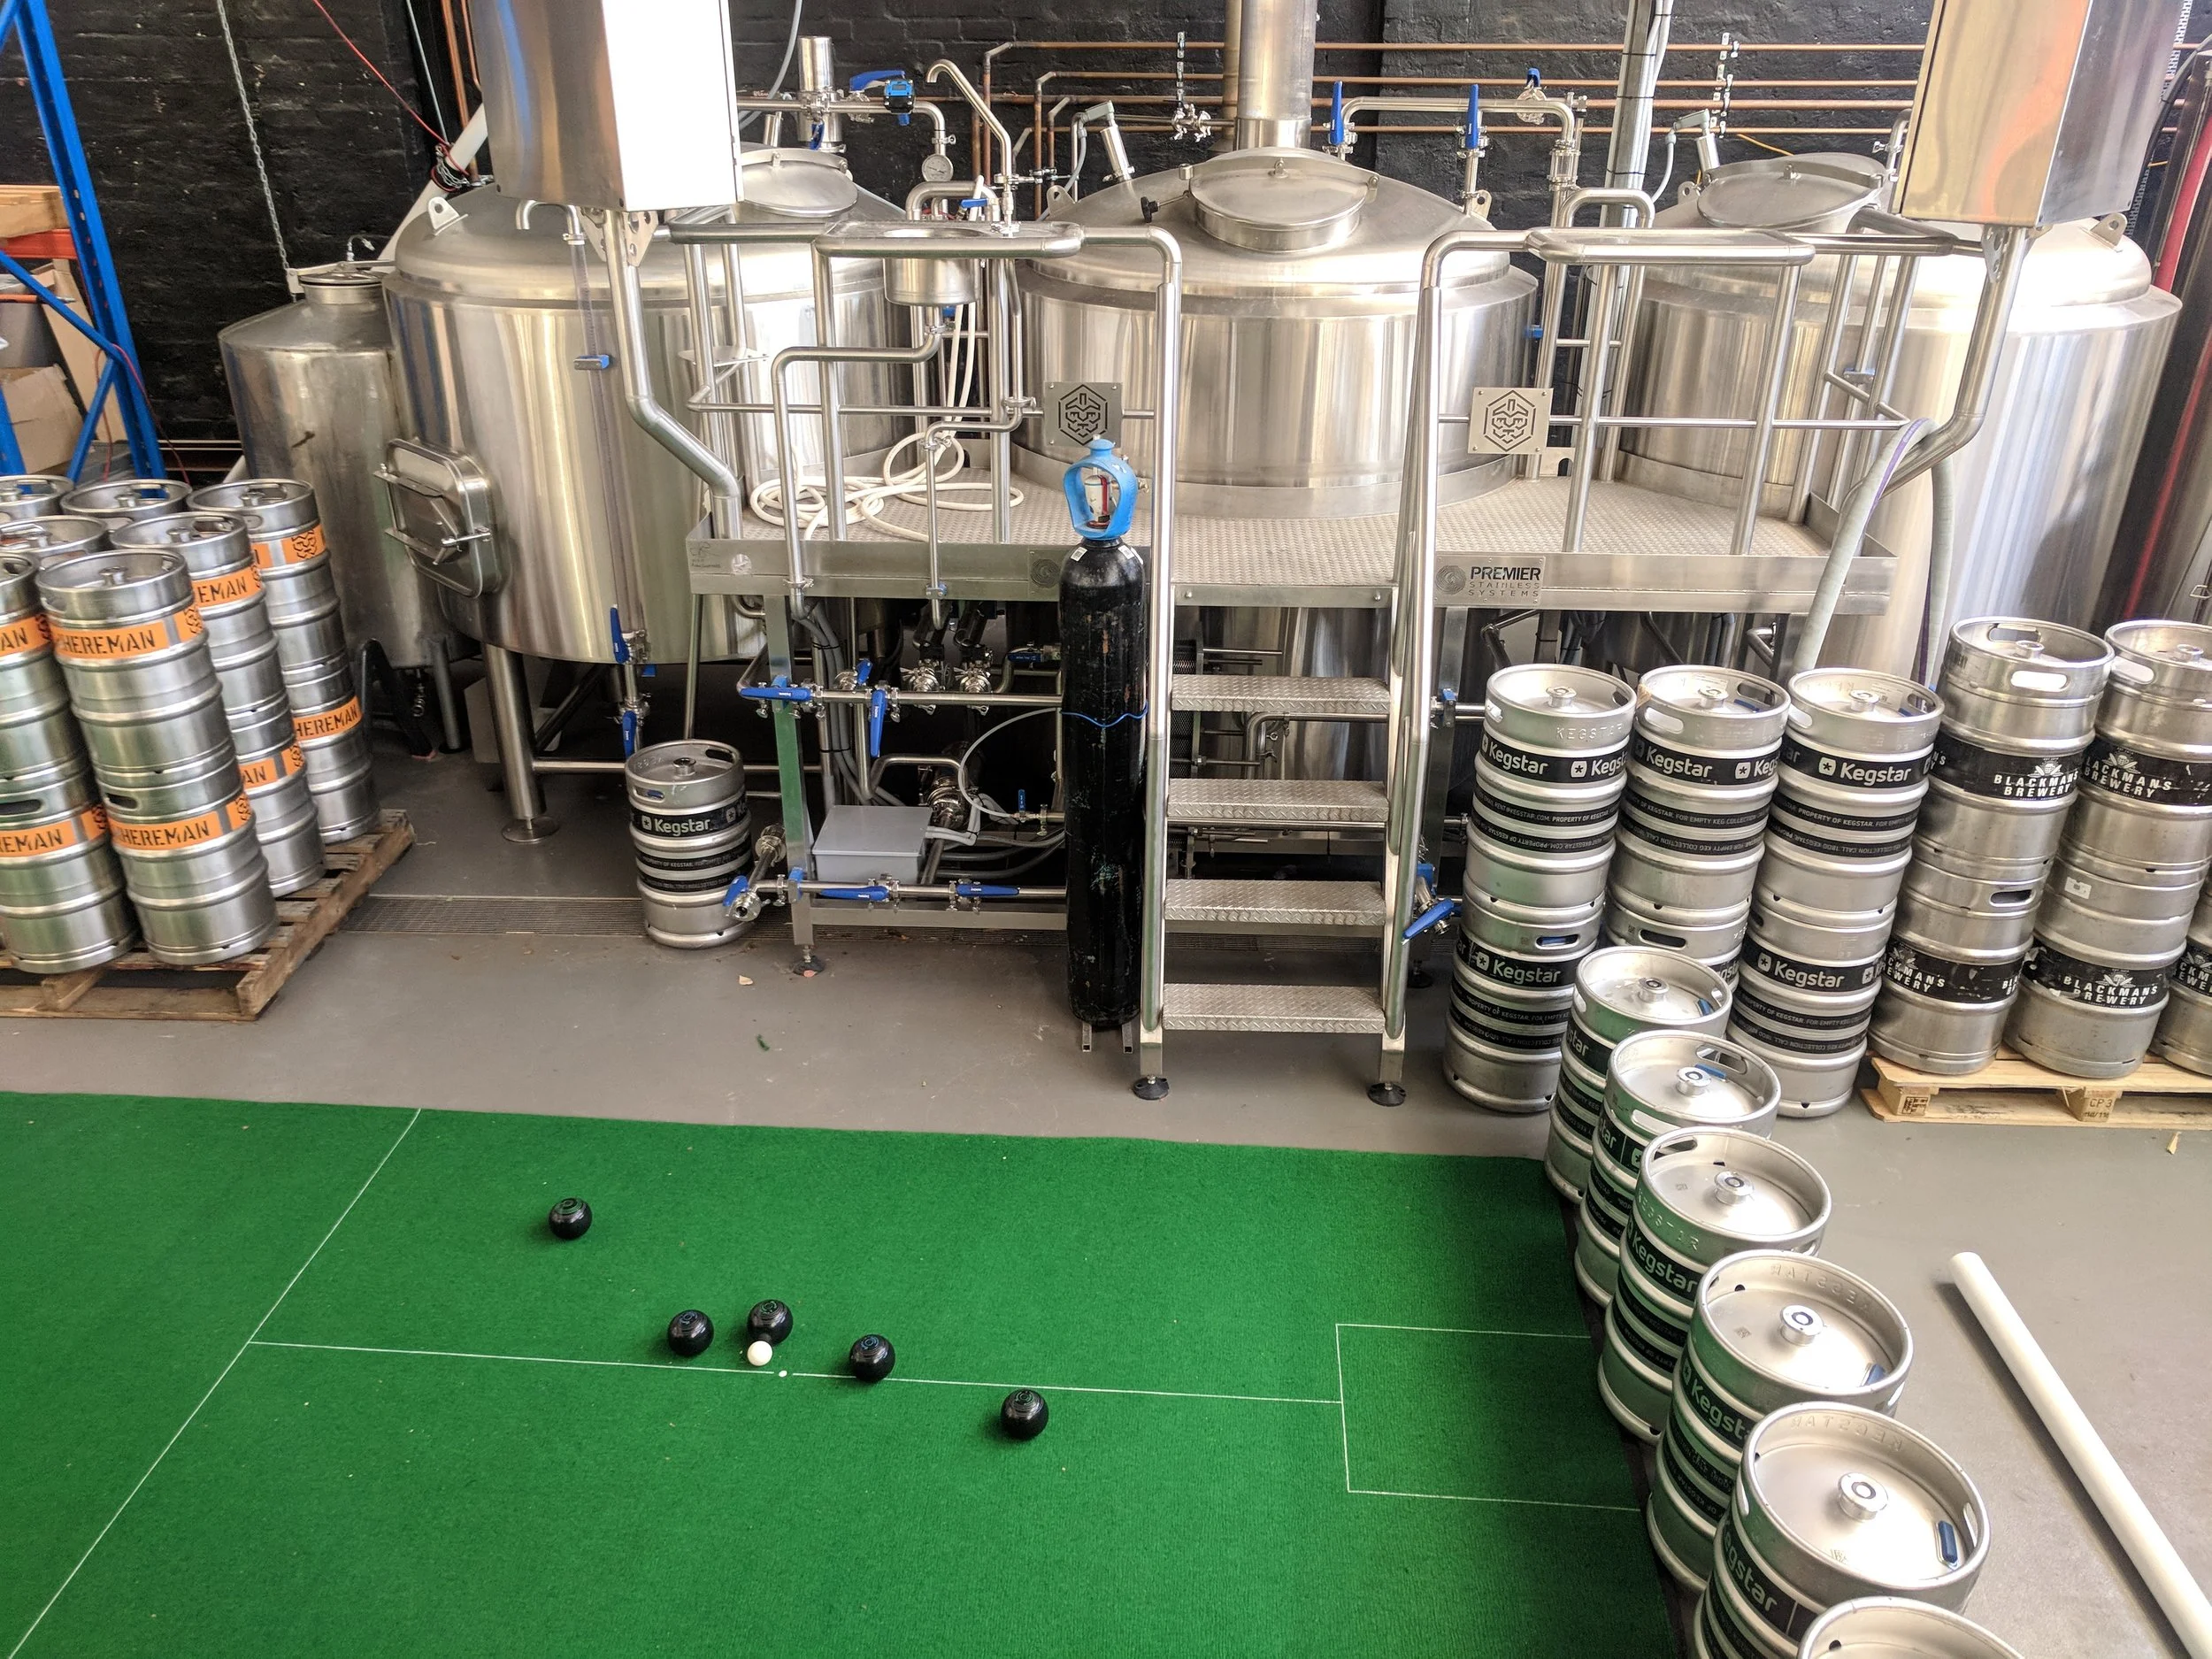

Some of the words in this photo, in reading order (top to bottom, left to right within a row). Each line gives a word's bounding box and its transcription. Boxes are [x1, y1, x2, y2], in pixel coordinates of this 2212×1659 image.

[1471, 566, 1541, 580] PREMIER
[197, 577, 248, 603] EMAN
[62, 629, 155, 655] HEREMAN
[296, 704, 358, 737] HEREMAN
[1489, 741, 1548, 775] Kegstar
[1591, 752, 1627, 777] Kegst
[1647, 745, 1713, 778] Kegstar
[1754, 759, 1778, 777] Kegs
[1840, 762, 1912, 787] Kegstar
[2084, 766, 2155, 798] BREWERY
[2085, 757, 2172, 791] LACKMAN'S
[2004, 783, 2070, 797] BREWERY
[655, 818, 711, 836] Kegstar
[1798, 808, 1831, 823] PROPERTY
[0, 828, 64, 854] EMAN
[120, 821, 209, 846] HEREMAN
[1660, 837, 1698, 850] COLLECTION
[1493, 958, 1561, 985] Kegstar
[1775, 961, 1845, 987] Kegstar
[1886, 968, 1932, 993] EWERY
[1888, 958, 1946, 987] CKMAN'S
[1568, 1030, 1589, 1057] star
[1632, 1236, 1698, 1293] Kegstar
[1691, 1379, 1751, 1440] Kegst
[1725, 1532, 1778, 1611] egstar
